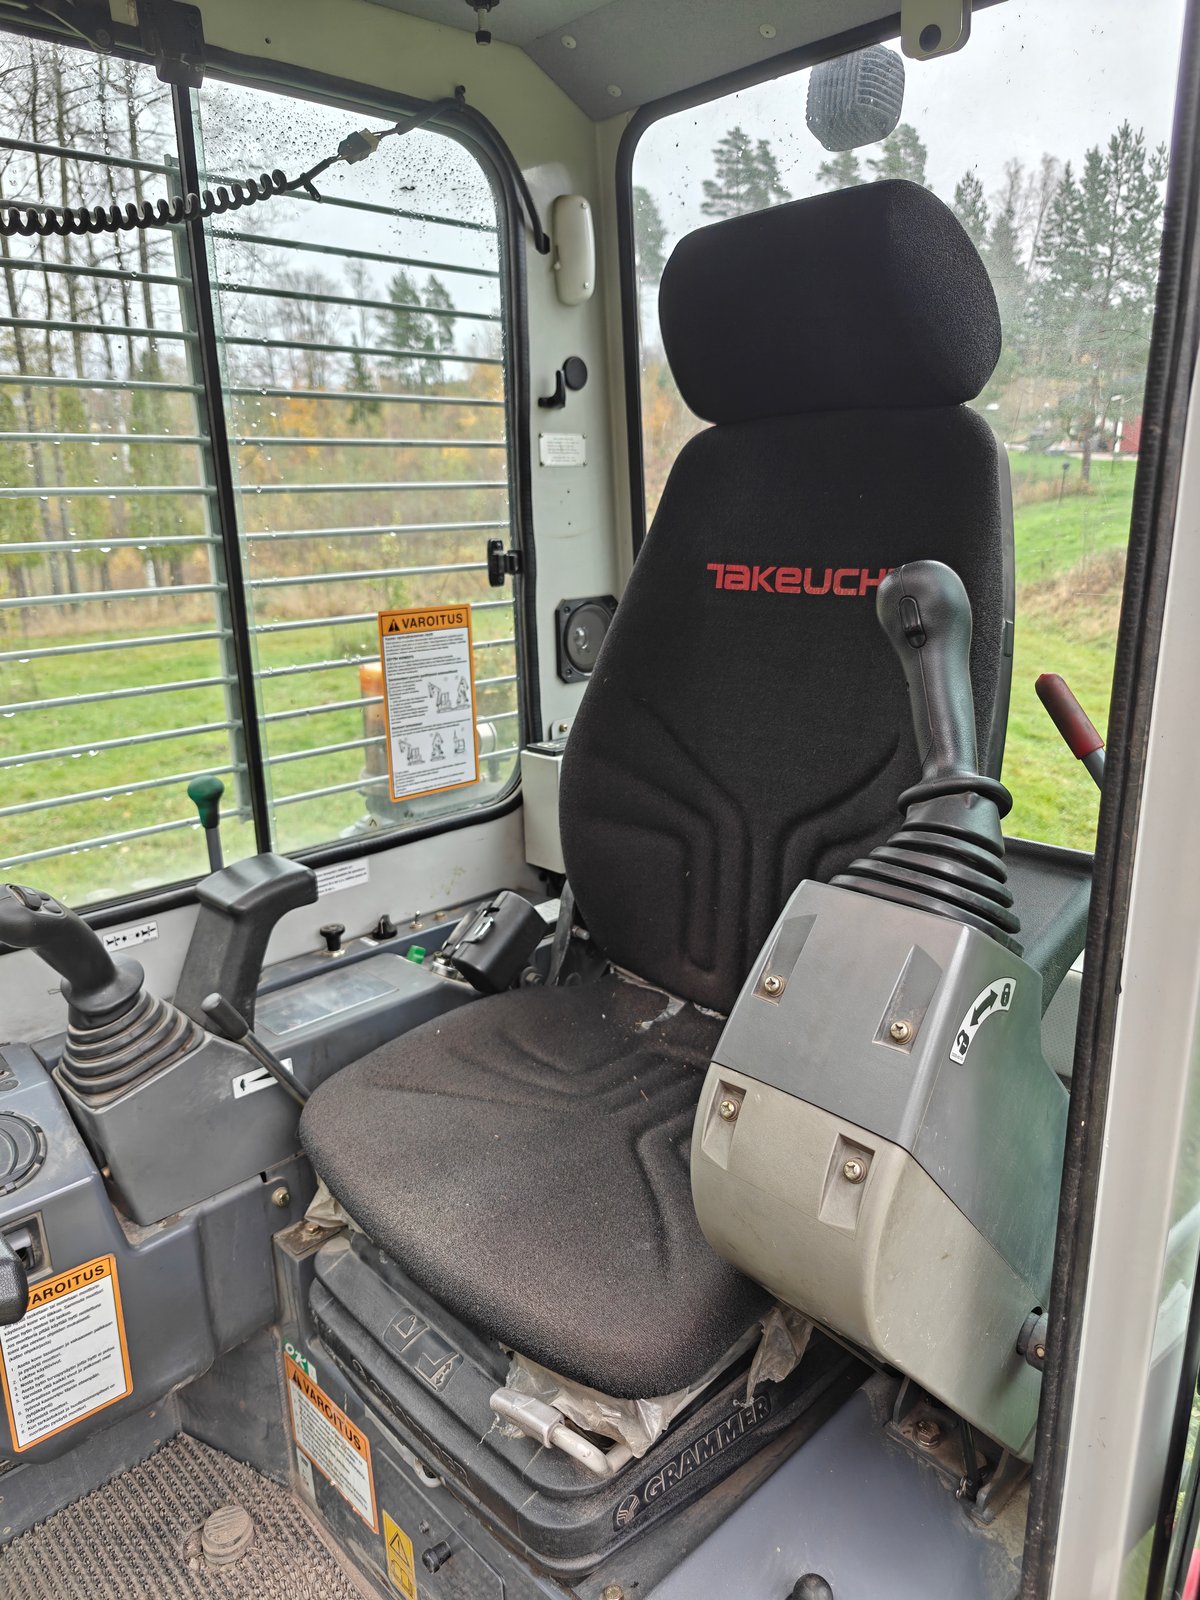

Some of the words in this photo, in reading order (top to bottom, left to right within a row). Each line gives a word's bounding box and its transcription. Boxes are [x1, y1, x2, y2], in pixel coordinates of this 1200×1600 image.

[402, 613, 463, 630] VAROITUS
[28, 1265, 105, 1307] AROITUS
[303, 1379, 362, 1451] VAROITUS
[644, 1395, 769, 1503] GRAMMER
